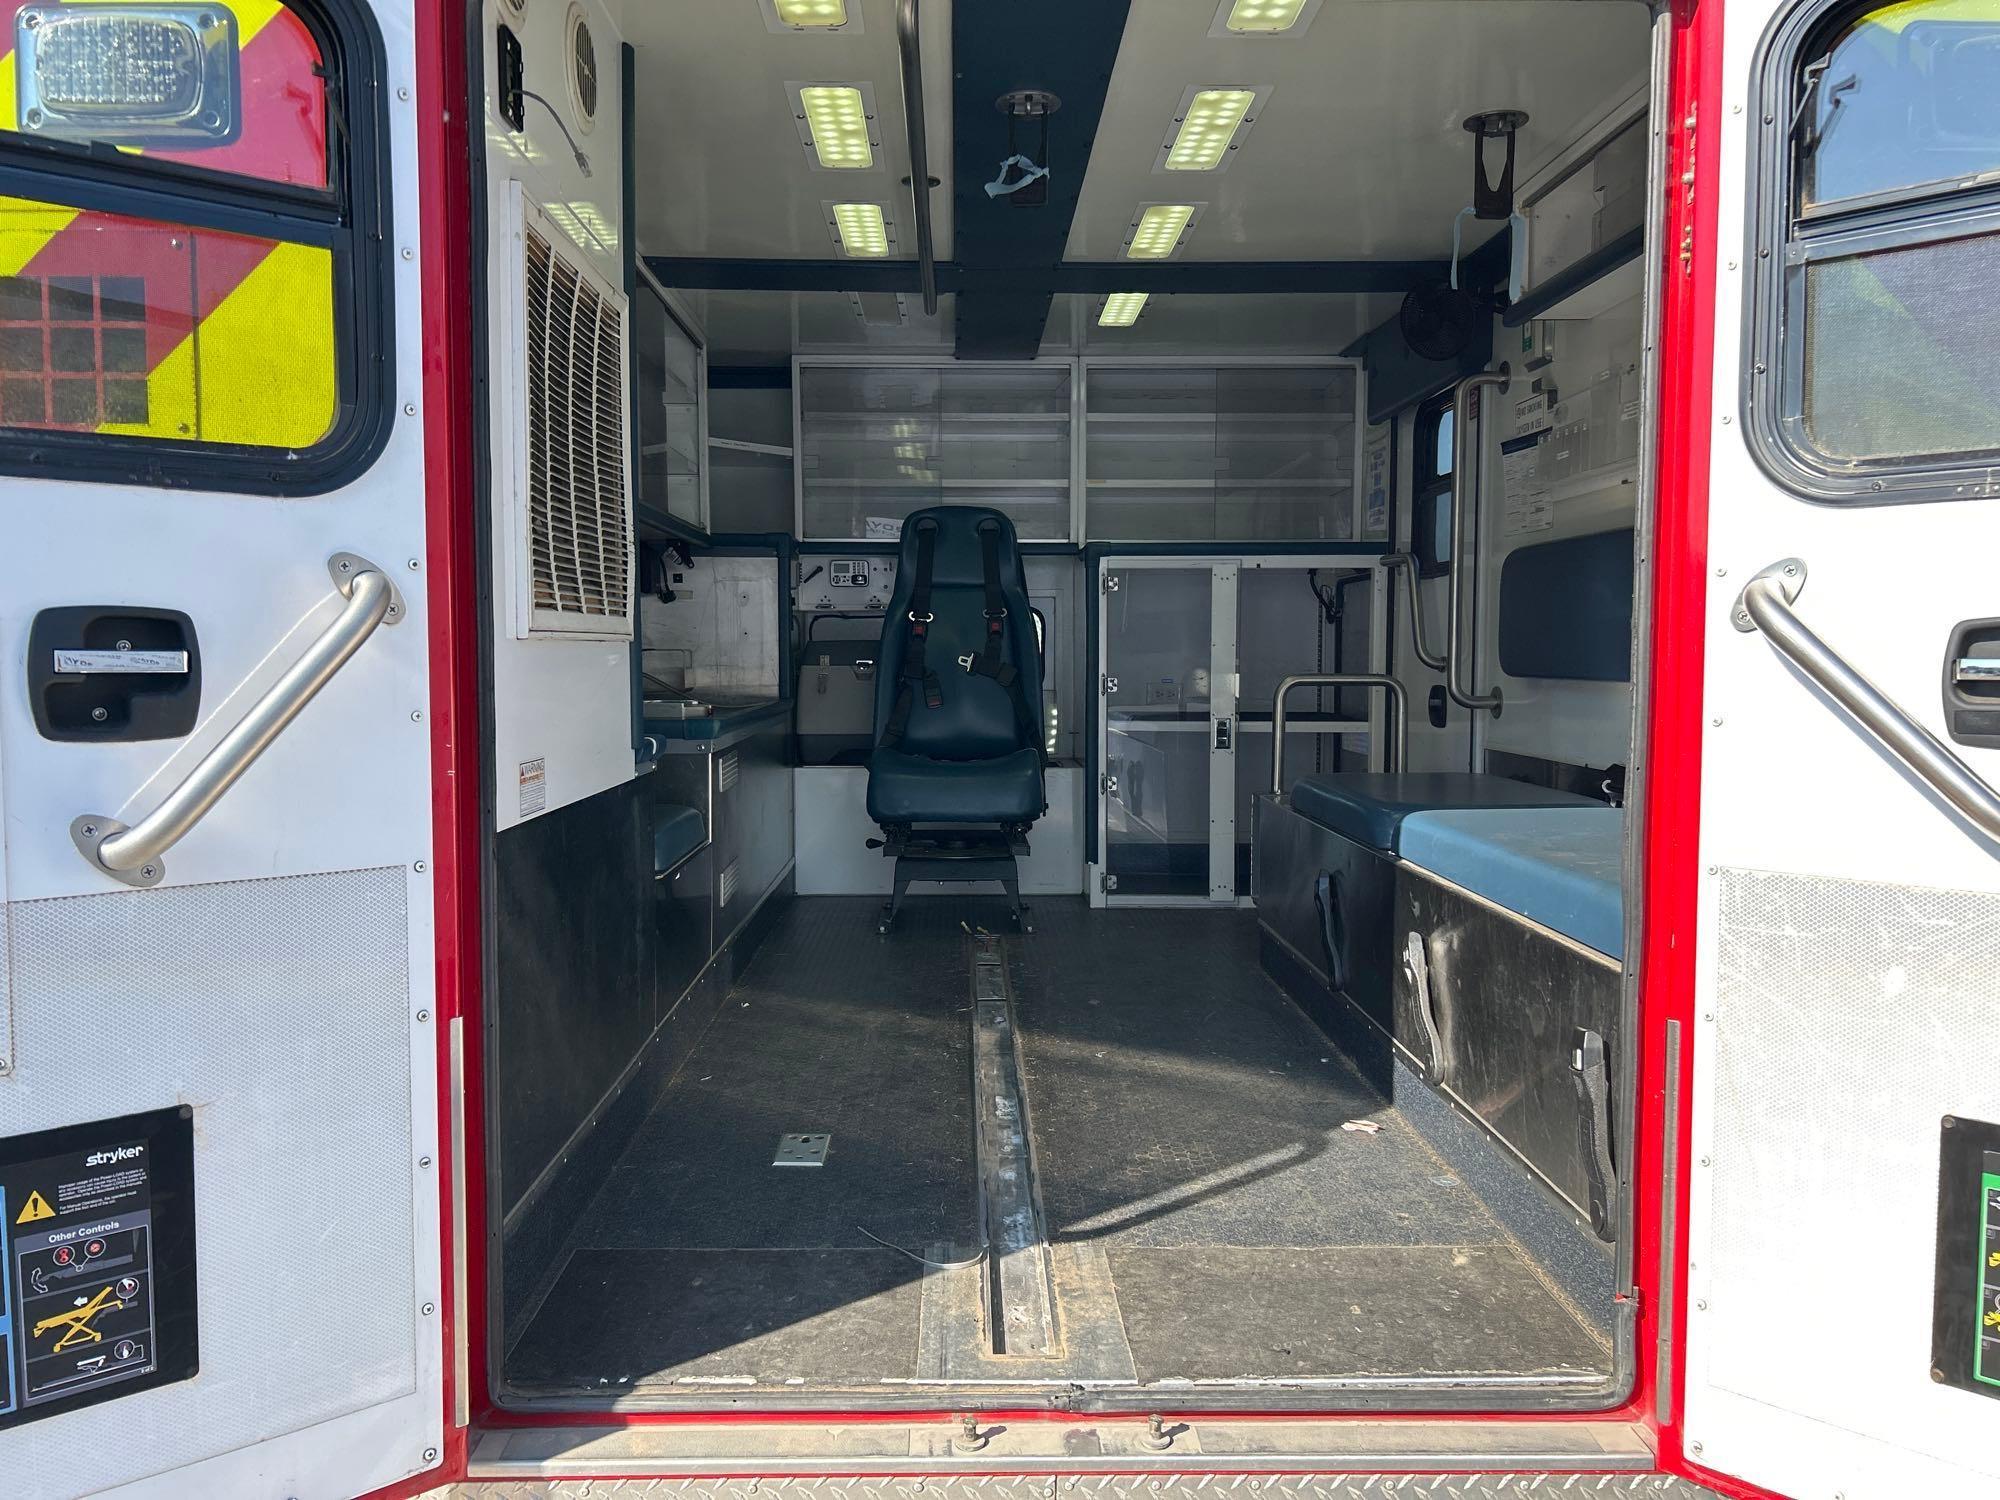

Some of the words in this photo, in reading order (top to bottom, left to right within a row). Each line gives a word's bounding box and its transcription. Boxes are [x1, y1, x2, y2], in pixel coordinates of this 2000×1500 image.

[86, 1146, 144, 1167] stryker
[48, 1231, 76, 1243] Other
[78, 1221, 119, 1237] Controls
